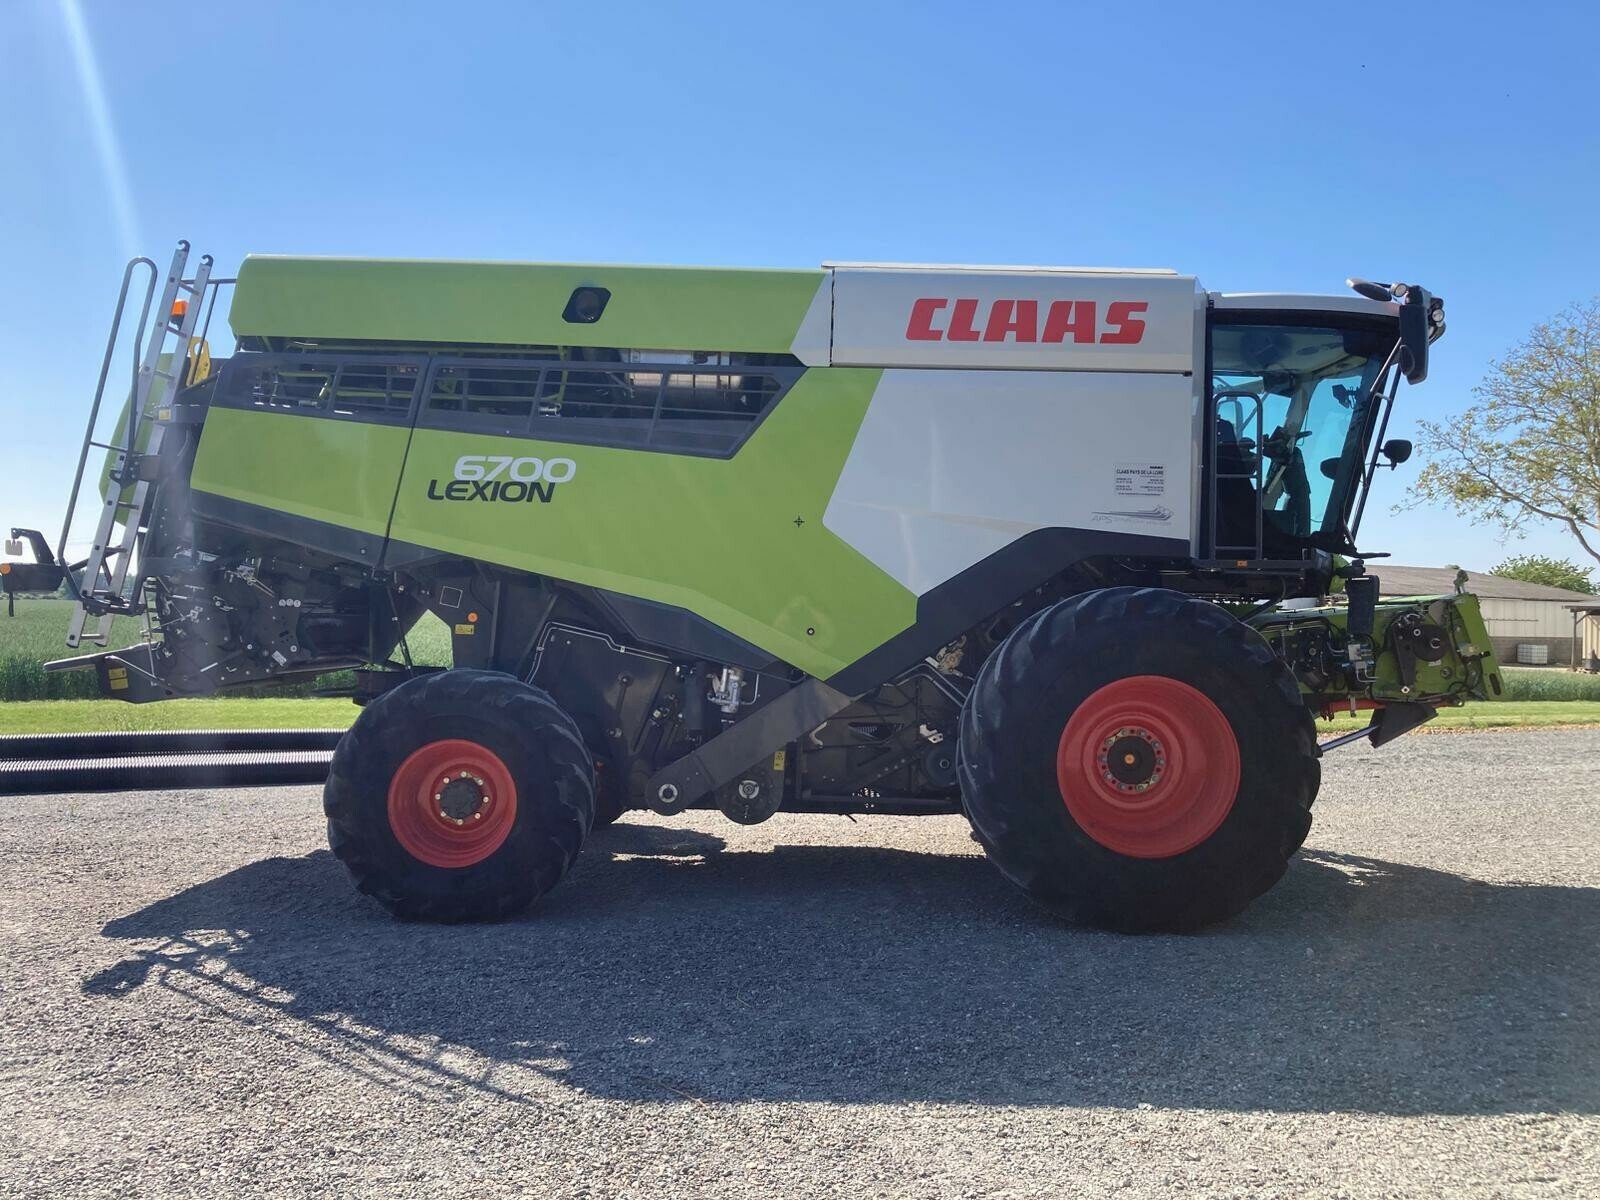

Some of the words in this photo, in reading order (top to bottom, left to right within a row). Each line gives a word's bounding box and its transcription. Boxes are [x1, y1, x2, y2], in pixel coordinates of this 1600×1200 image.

[906, 298, 1149, 344] CLAAS
[454, 455, 577, 483] 6700
[427, 479, 556, 503] LEXION
